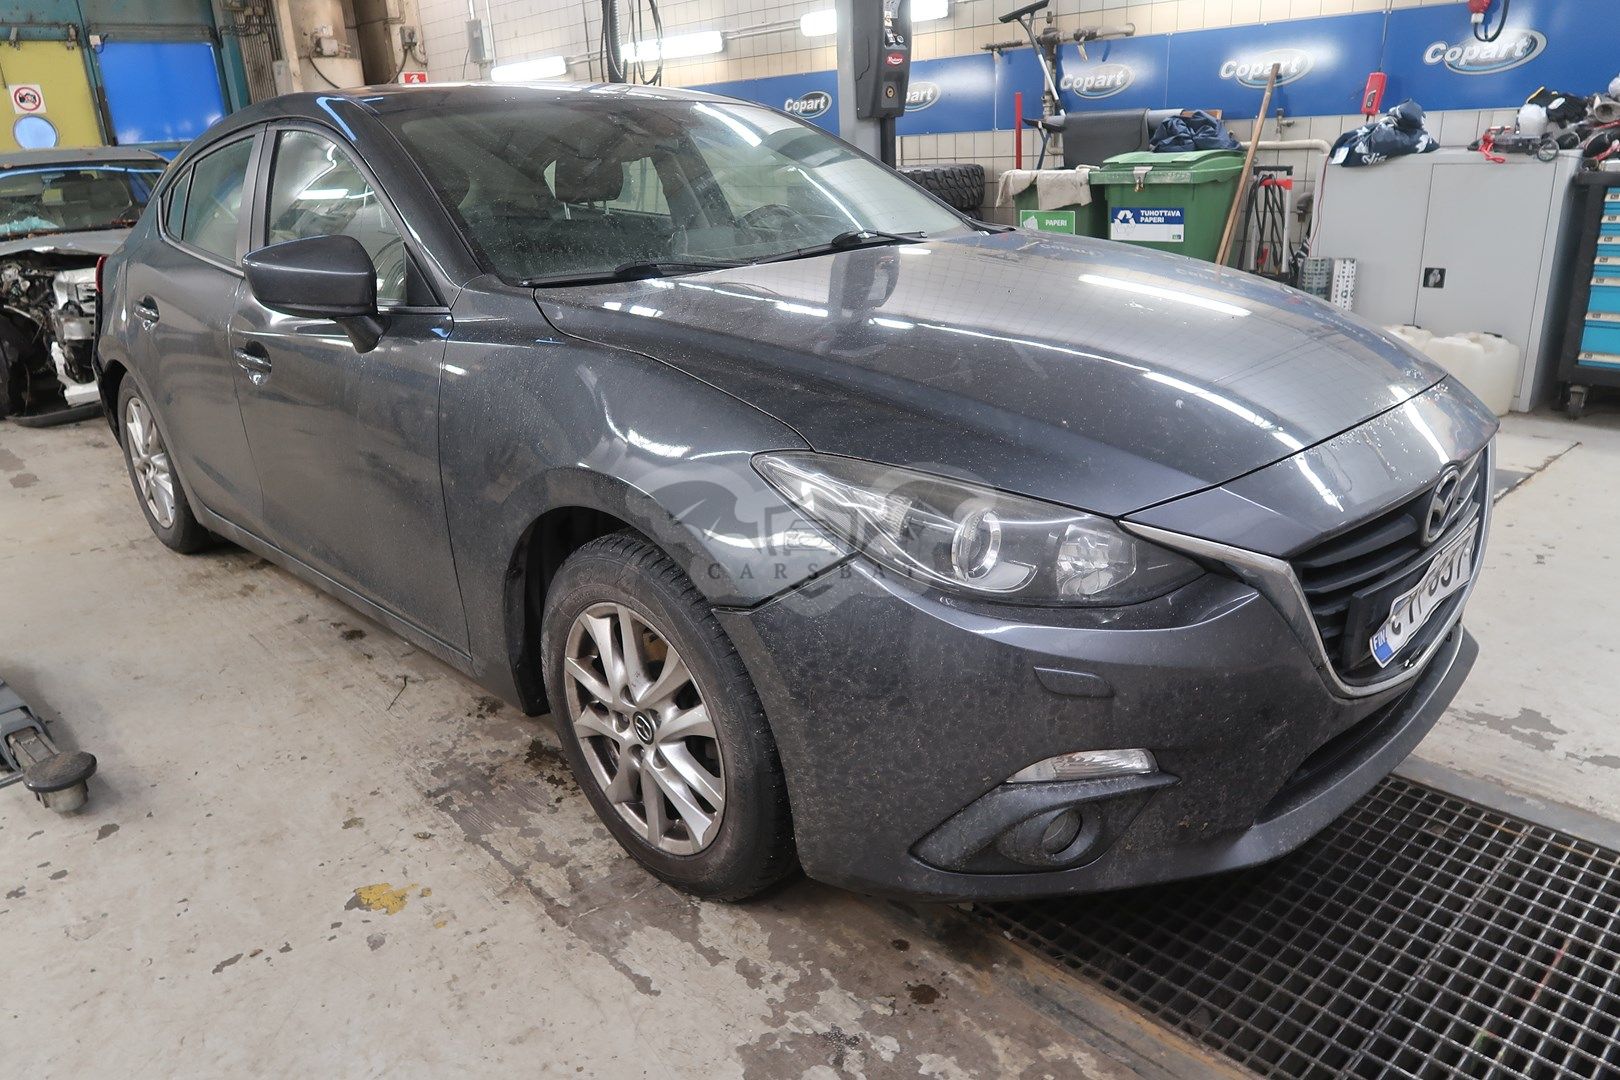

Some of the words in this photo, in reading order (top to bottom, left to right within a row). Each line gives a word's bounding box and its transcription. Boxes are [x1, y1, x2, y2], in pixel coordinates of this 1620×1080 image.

[1424, 36, 1530, 67] Copart
[1060, 70, 1123, 91] Copart
[784, 96, 826, 113] Copart
[1140, 209, 1181, 217] TUHOTTAVA
[1045, 219, 1068, 227] PAPERI
